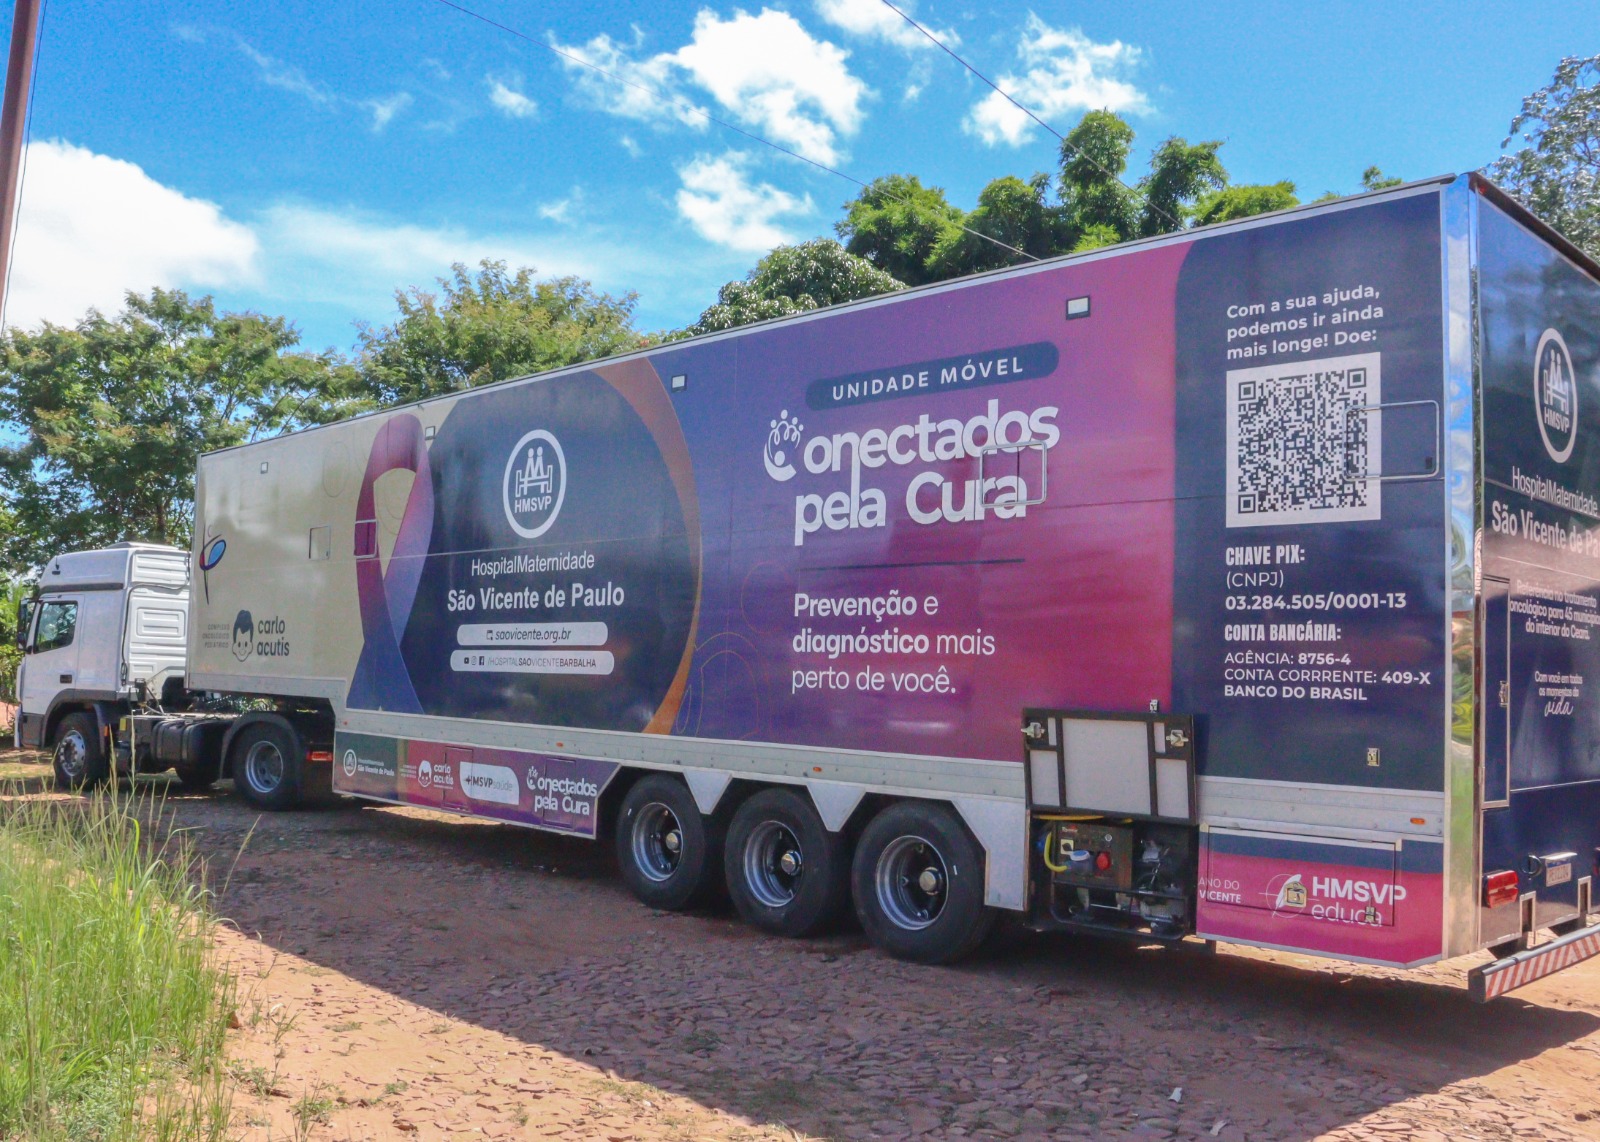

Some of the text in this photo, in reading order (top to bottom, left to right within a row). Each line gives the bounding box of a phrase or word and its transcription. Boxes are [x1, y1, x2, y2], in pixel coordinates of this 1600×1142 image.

[1227, 284, 1380, 319] Com a sua ajuda,
[1227, 304, 1383, 342] podemos ir ainda
[1227, 329, 1377, 360] mais longe! Doe:
[832, 356, 1023, 400] UNIDADE MÓVEL
[1544, 406, 1570, 434] HMSVP
[514, 496, 552, 513] HMSVP
[794, 471, 1028, 546] pela Cura
[1492, 500, 1600, 559] São Vicente de Pa
[471, 551, 595, 579] HospitalMaternidade
[1225, 544, 1306, 566] CHAVE PIX:
[1226, 569, 1284, 589] (CNPJ)
[448, 581, 625, 612] São Vicente de Paulo
[794, 589, 939, 623] Prevenção e
[1225, 592, 1407, 611] 03.284.505/0001-13
[258, 616, 286, 634] carlo
[495, 627, 571, 643] saovicente.org.br
[1224, 620, 1342, 642] CONTA BANCÁRIA:
[257, 637, 290, 656] acutis
[792, 627, 996, 659] diagnóstico mais
[1224, 649, 1351, 666] AGÊNCIA: 8756-4
[792, 665, 956, 695] perto de você.
[1224, 669, 1431, 686] CONTA CORRRENTE: 409-X
[1224, 685, 1368, 701] BANCO DO BRASIL
[1544, 694, 1574, 717] vida
[534, 793, 590, 816] pela Cura
[1199, 889, 1241, 903] VICENTE
[1224, 879, 1240, 891] DO
[1312, 876, 1407, 906] HMSVP
